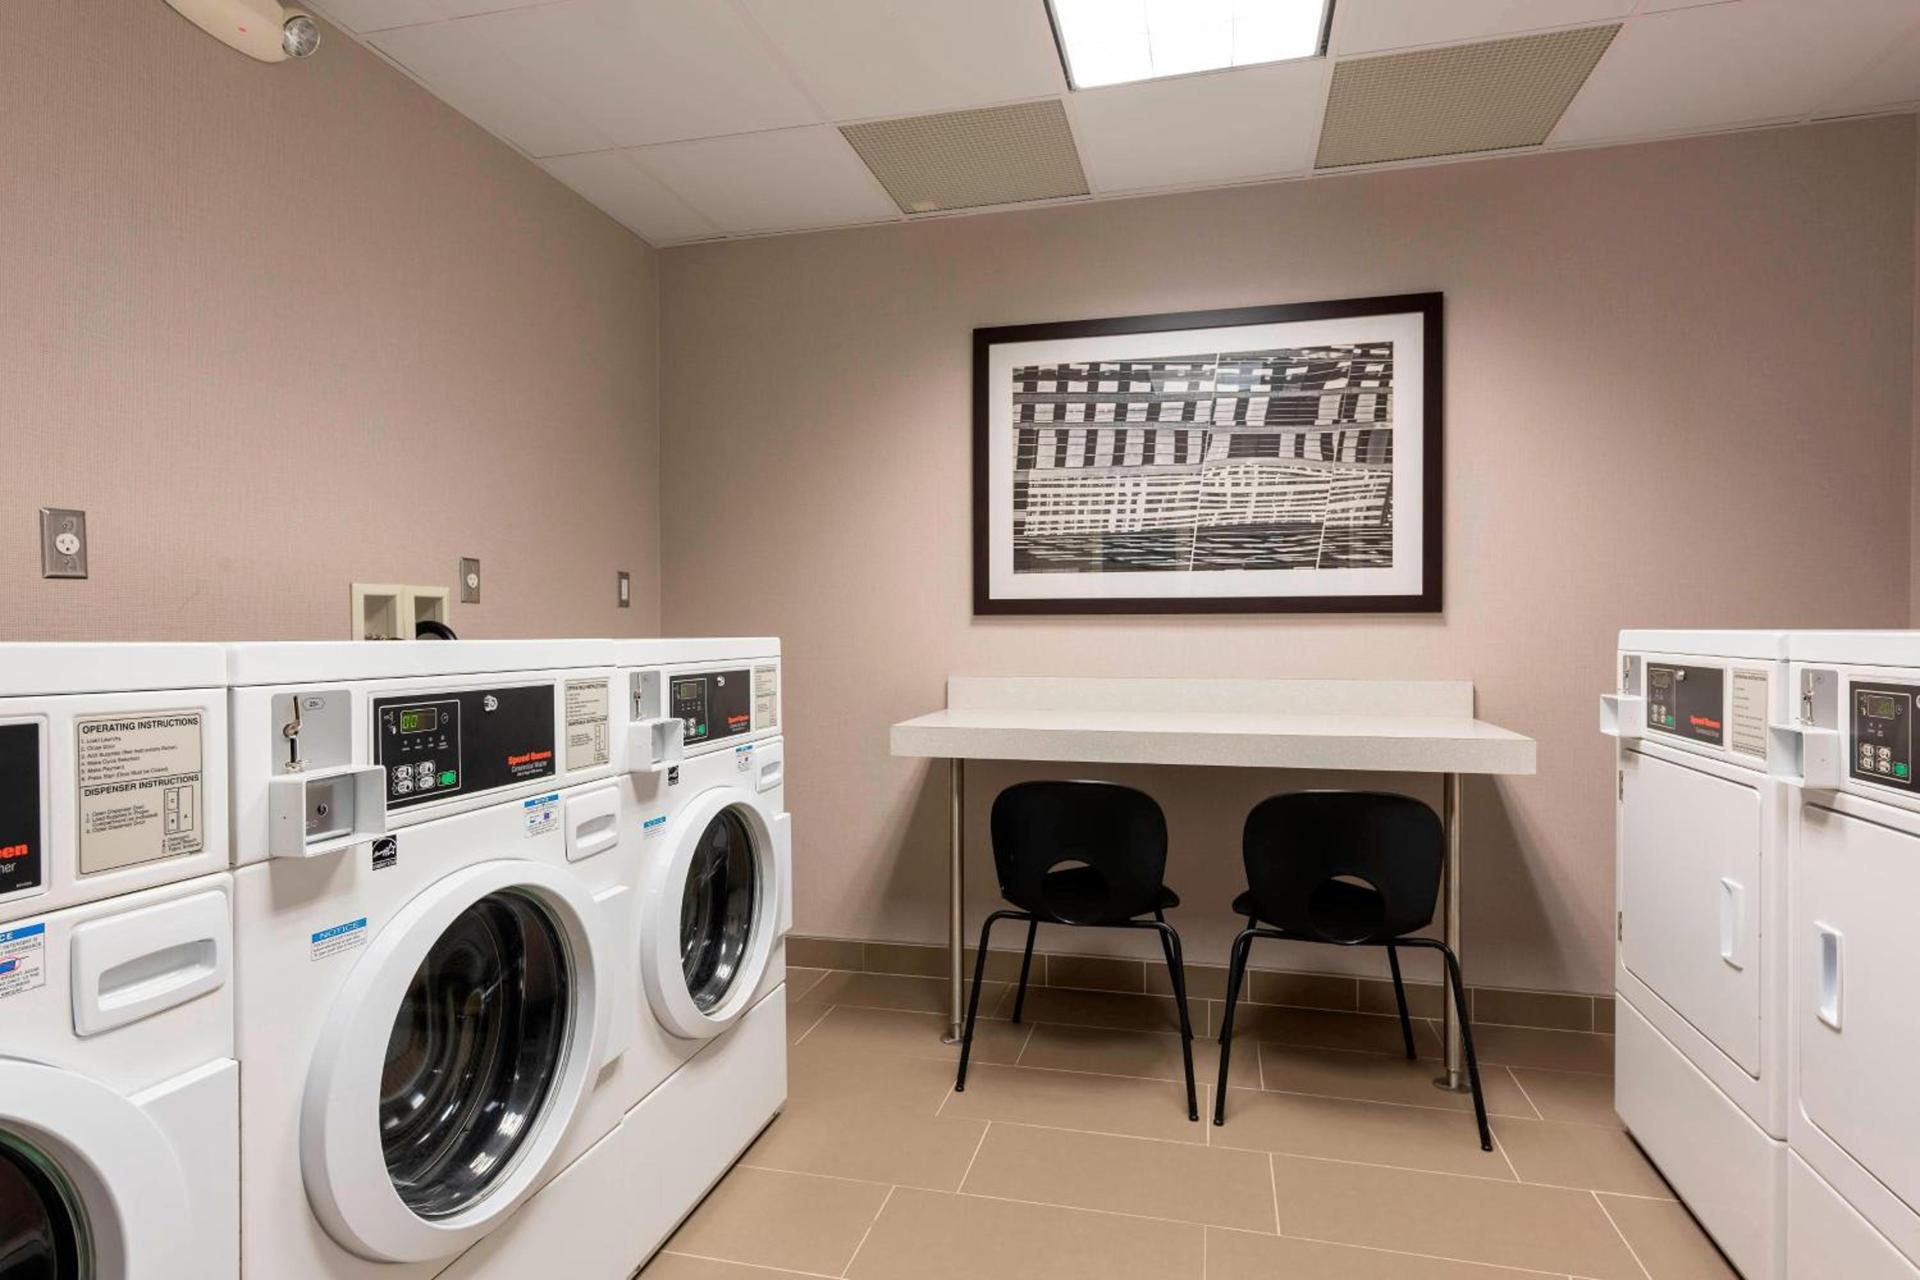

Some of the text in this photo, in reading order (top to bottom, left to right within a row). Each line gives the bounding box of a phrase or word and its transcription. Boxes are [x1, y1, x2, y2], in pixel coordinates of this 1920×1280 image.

[82, 717, 199, 734] OPERATING INSTRUCTIONS
[84, 773, 200, 797] DISPENSER INSTRUCTIONS
